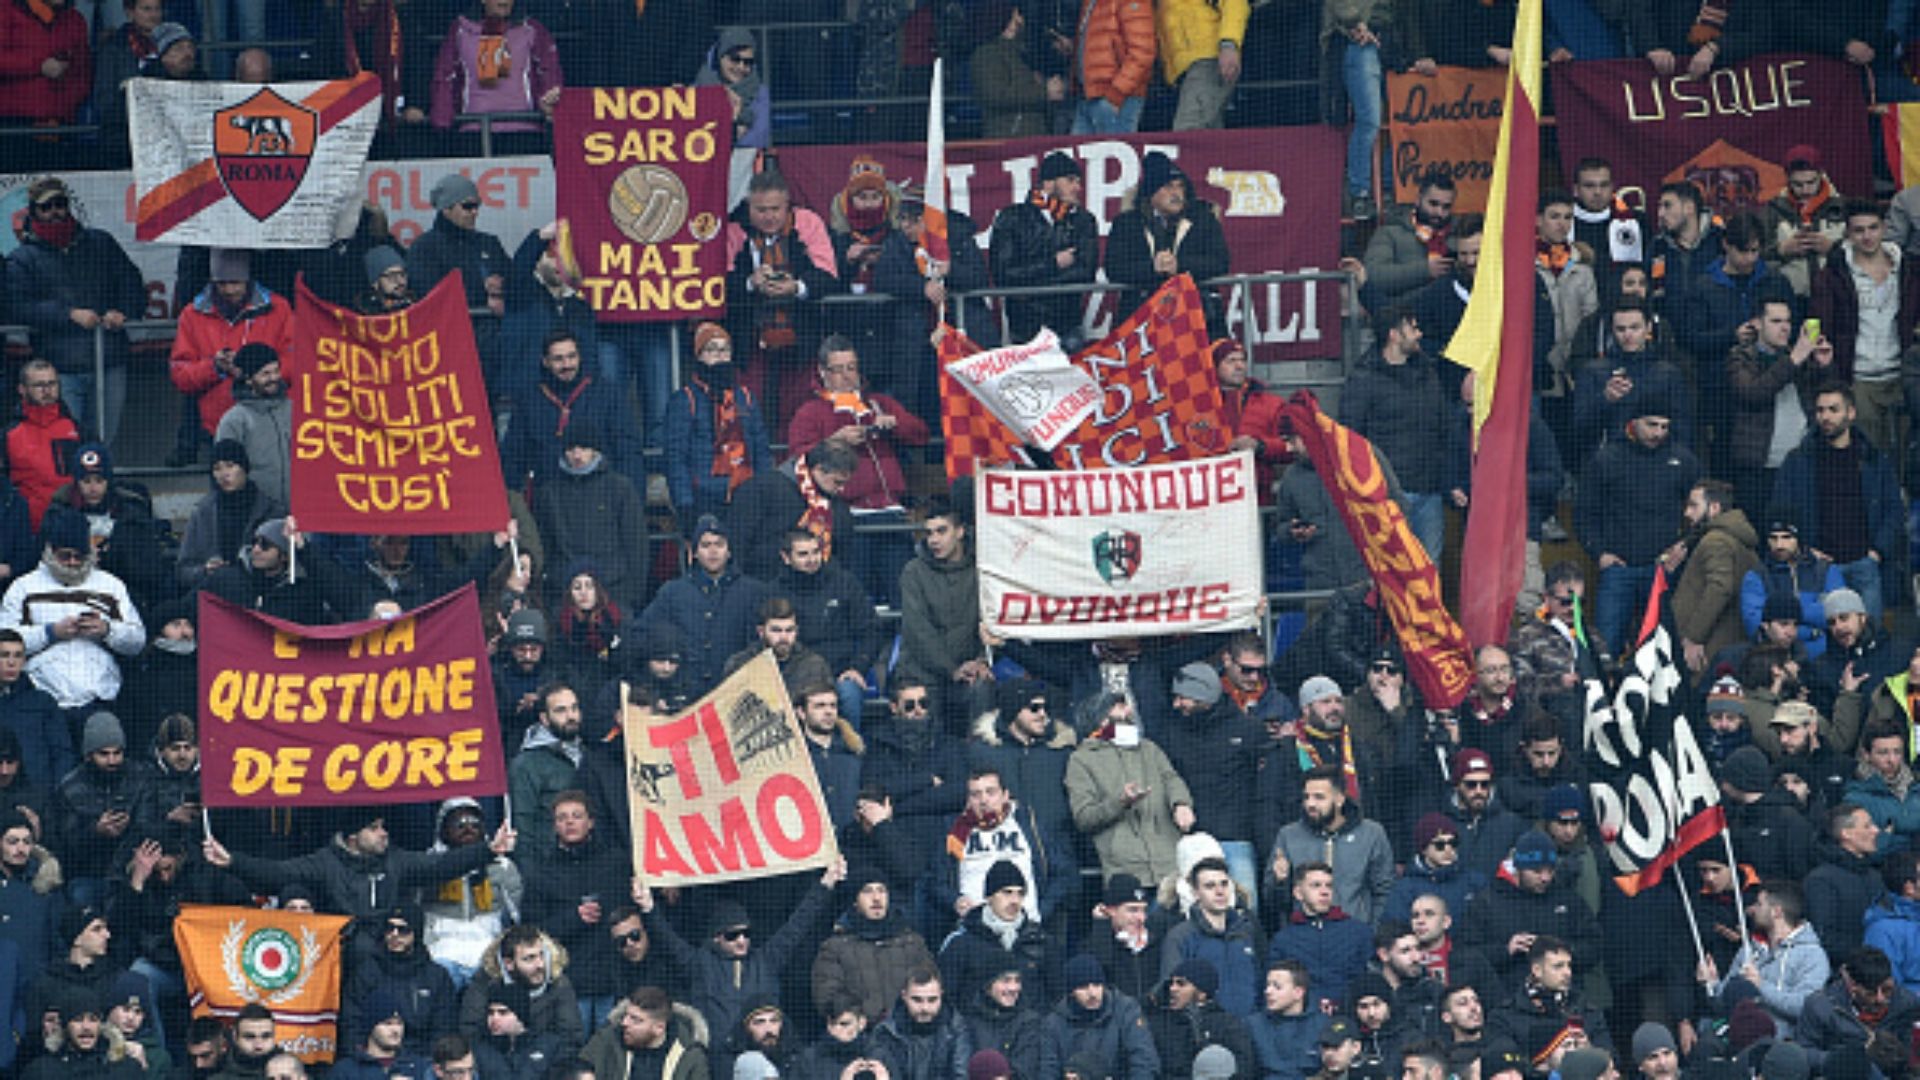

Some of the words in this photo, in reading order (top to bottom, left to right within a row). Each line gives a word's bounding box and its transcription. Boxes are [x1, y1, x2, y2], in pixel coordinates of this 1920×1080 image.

[593, 87, 697, 120] NON
[1394, 83, 1503, 126] Andre
[1623, 60, 1812, 121] USQUE
[583, 121, 719, 165] SARÓ
[228, 163, 297, 182] ROMA
[600, 241, 702, 277] MAI
[575, 275, 726, 311] TANCO
[316, 329, 441, 385] SIAMO
[302, 373, 313, 414] I
[324, 372, 464, 427] SOLITI
[296, 415, 482, 467] SEMPRE
[984, 457, 1246, 518] COMUNQUE
[997, 582, 1231, 626] OVUNQUE
[208, 656, 477, 723] QUESTIONE
[230, 746, 312, 796] DE
[323, 728, 484, 794] CORE
[647, 700, 741, 801] TI
[642, 772, 823, 878] AMO
